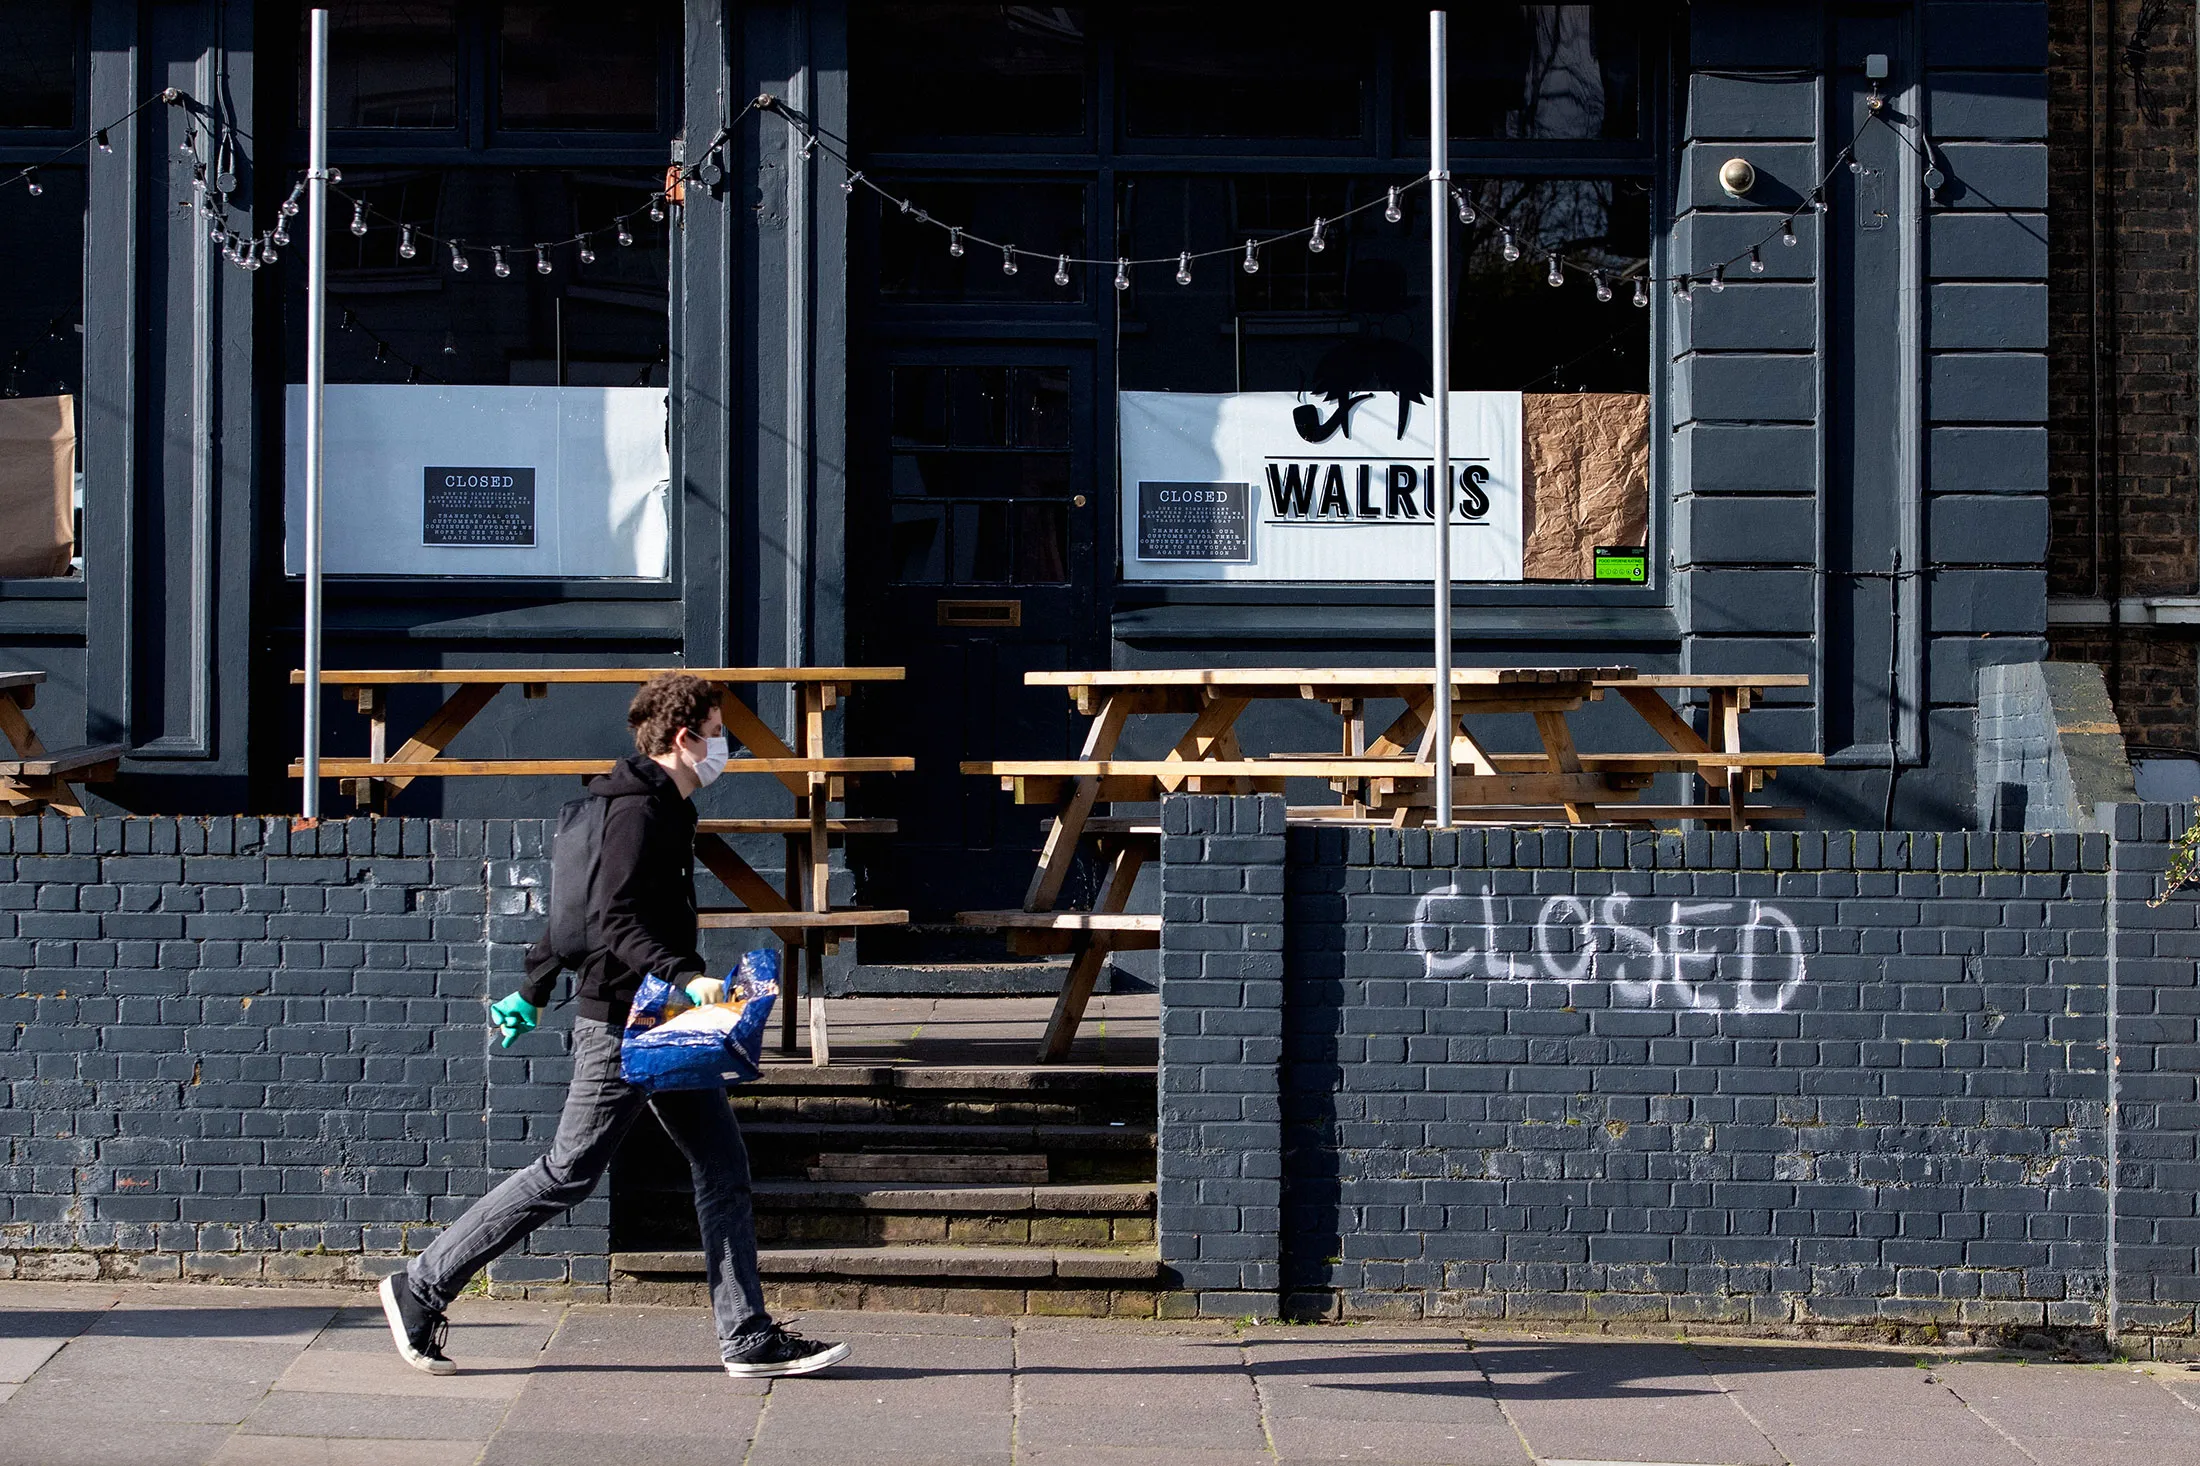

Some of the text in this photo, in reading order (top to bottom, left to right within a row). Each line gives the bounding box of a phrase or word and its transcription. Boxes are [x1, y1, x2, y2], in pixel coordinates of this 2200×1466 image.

[445, 475, 514, 488] CLOSED
[1160, 490, 1228, 503] CLOSED
[1265, 463, 1490, 519] WALRUS
[1414, 884, 1803, 1014] CLOSED
